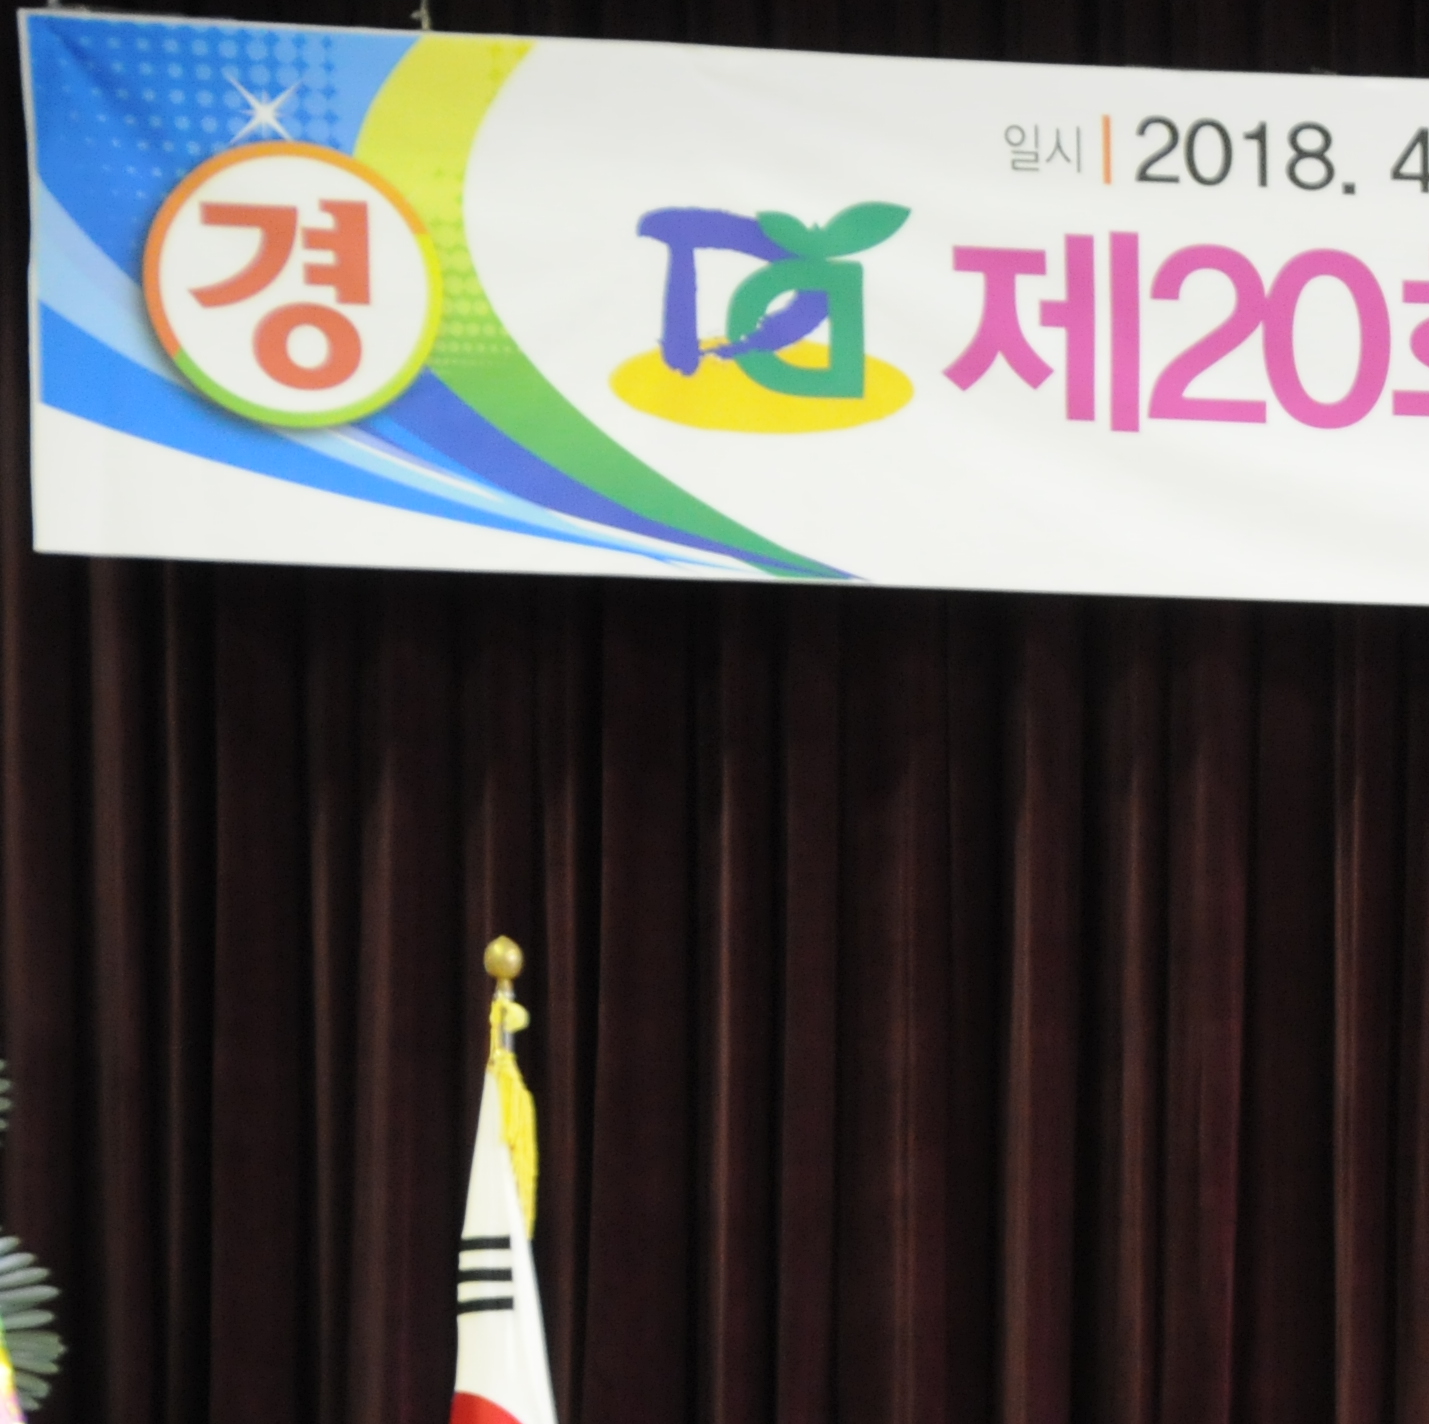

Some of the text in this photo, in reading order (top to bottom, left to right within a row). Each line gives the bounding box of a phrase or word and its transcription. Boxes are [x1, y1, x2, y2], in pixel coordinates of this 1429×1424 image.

[1004, 124, 1081, 173] 일시
[1136, 116, 1355, 194] 2018.
[188, 198, 373, 391] 경
